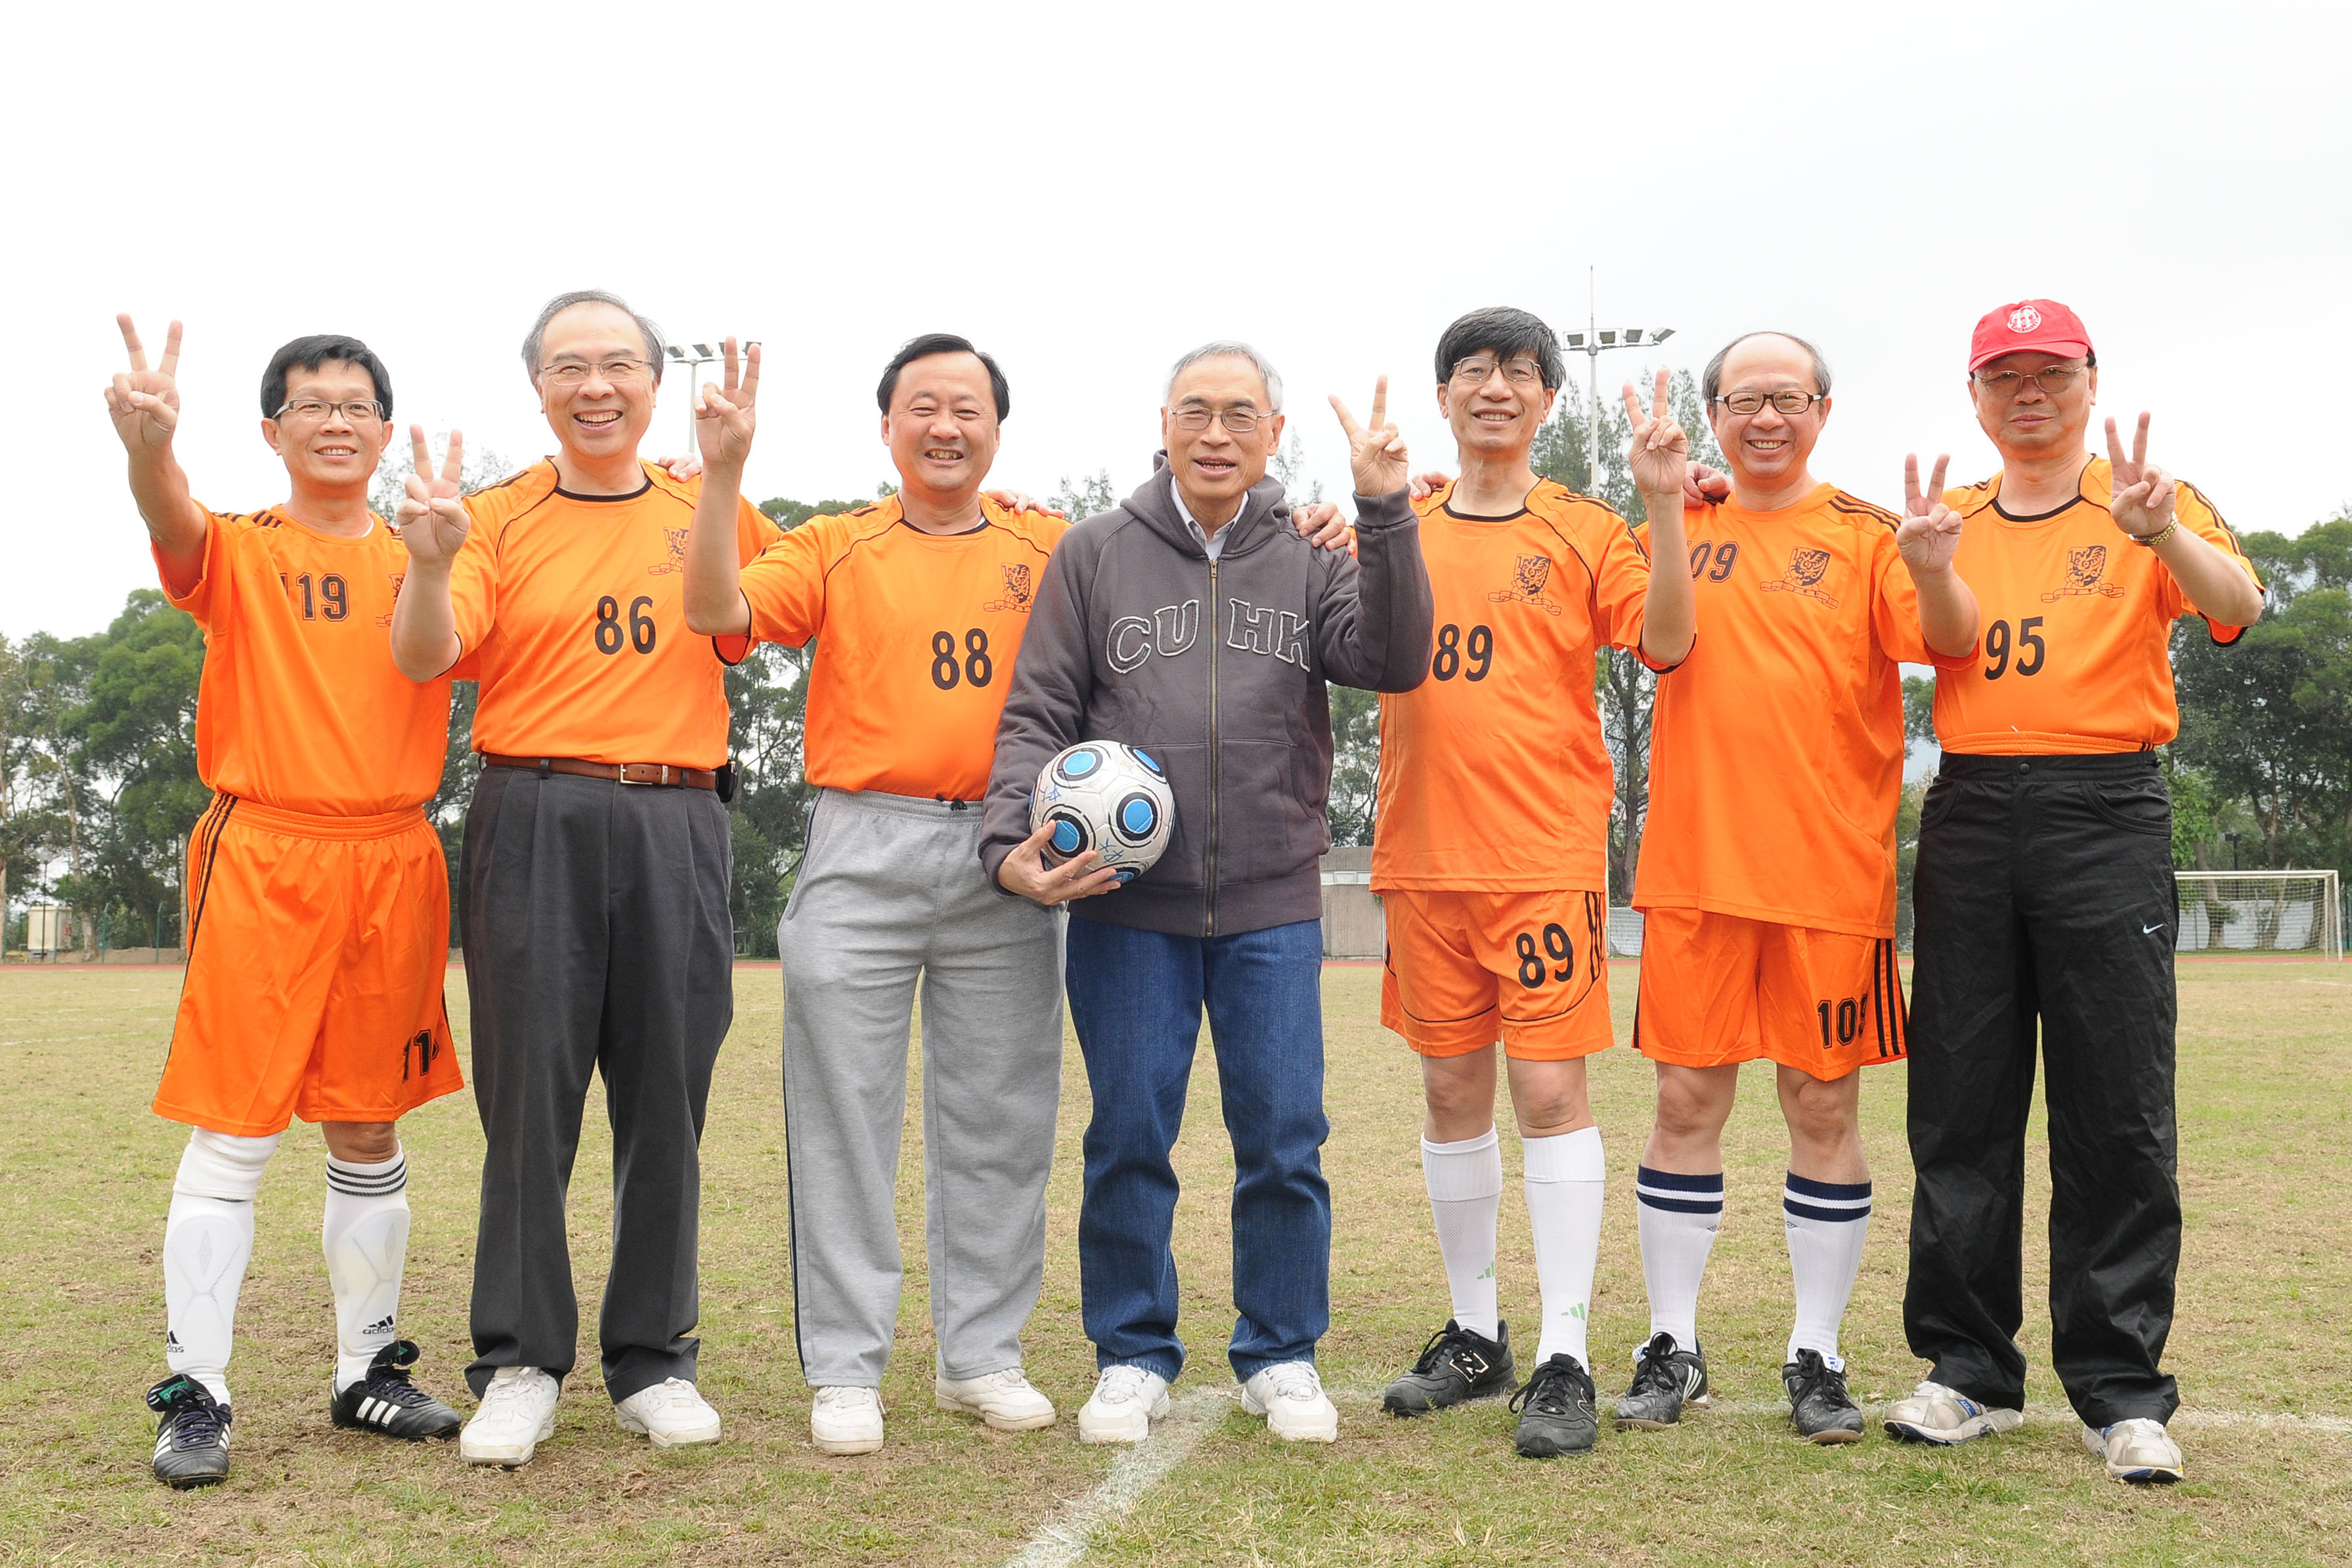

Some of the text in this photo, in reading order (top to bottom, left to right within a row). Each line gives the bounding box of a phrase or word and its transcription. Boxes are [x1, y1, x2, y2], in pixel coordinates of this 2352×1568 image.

[595, 596, 656, 655] 86
[1433, 623, 1493, 682] 89
[1984, 616, 2045, 680] 95
[931, 628, 992, 690] 88
[1516, 923, 1573, 989] 89
